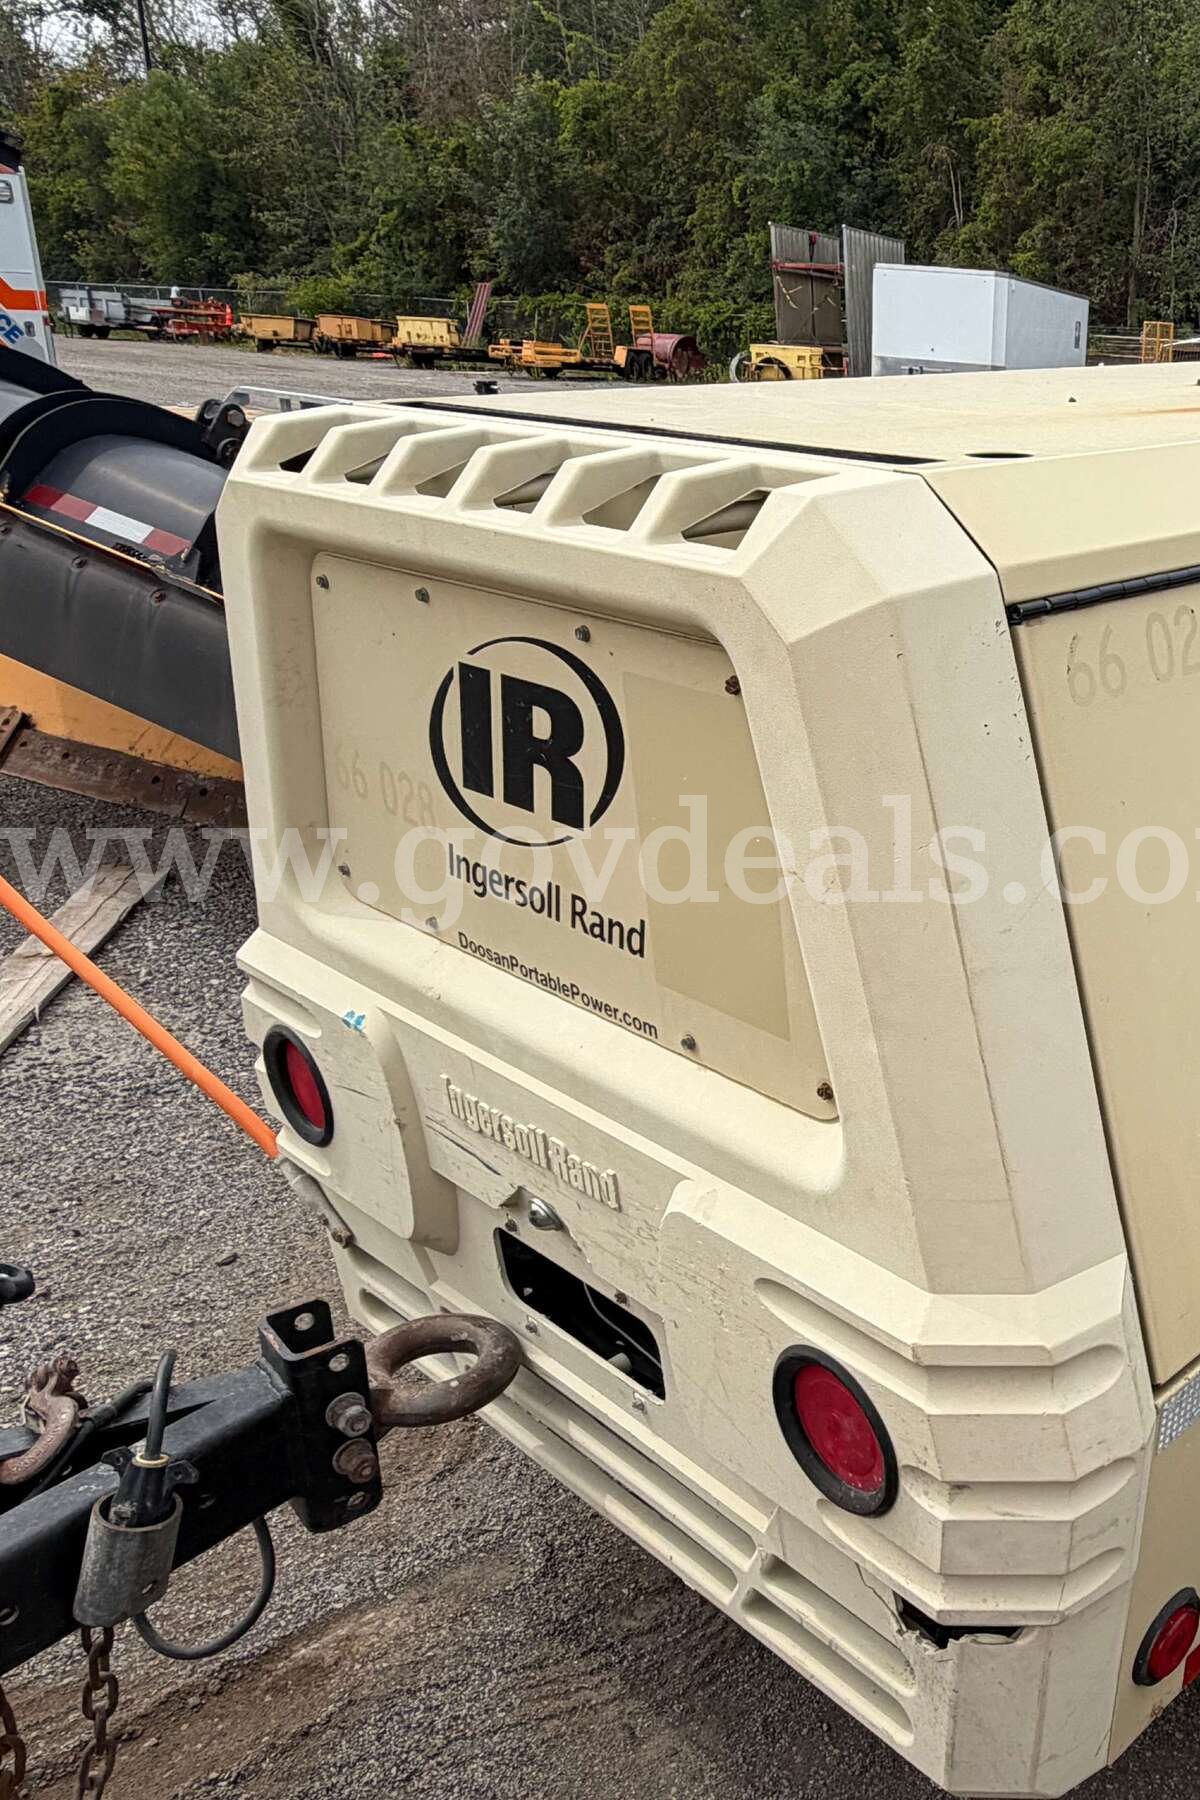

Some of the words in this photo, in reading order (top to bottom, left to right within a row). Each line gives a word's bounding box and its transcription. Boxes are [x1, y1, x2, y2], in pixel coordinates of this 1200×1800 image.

[1067, 624, 1127, 707] 66
[458, 660, 585, 831] IR
[448, 842, 561, 923] Ingersoll
[570, 893, 646, 959] Rand
[457, 930, 658, 1040] DoosanPortablePower.com
